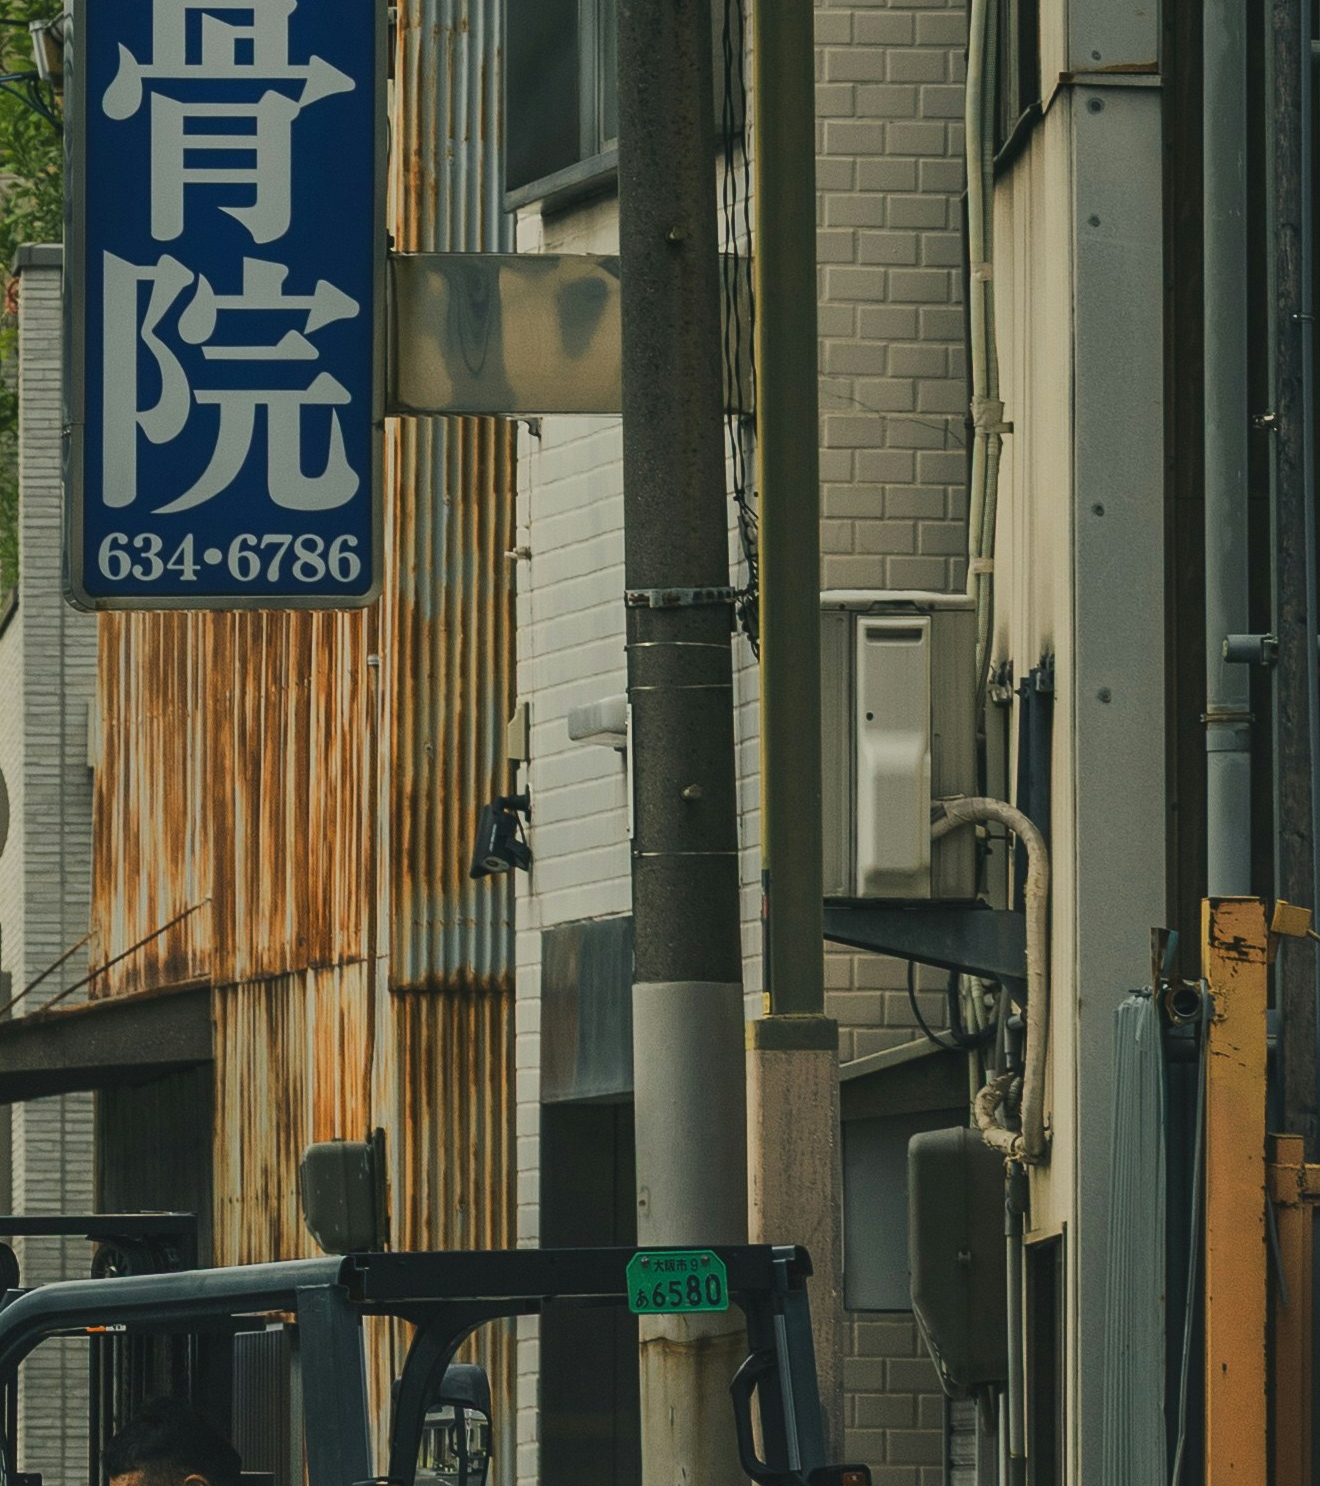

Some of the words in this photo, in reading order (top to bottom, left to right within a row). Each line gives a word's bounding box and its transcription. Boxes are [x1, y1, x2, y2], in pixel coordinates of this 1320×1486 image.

[653, 1259, 687, 1272] 大阪市
[690, 1258, 699, 1272] 9
[635, 1287, 649, 1309] あ
[652, 1273, 722, 1308] 6580
